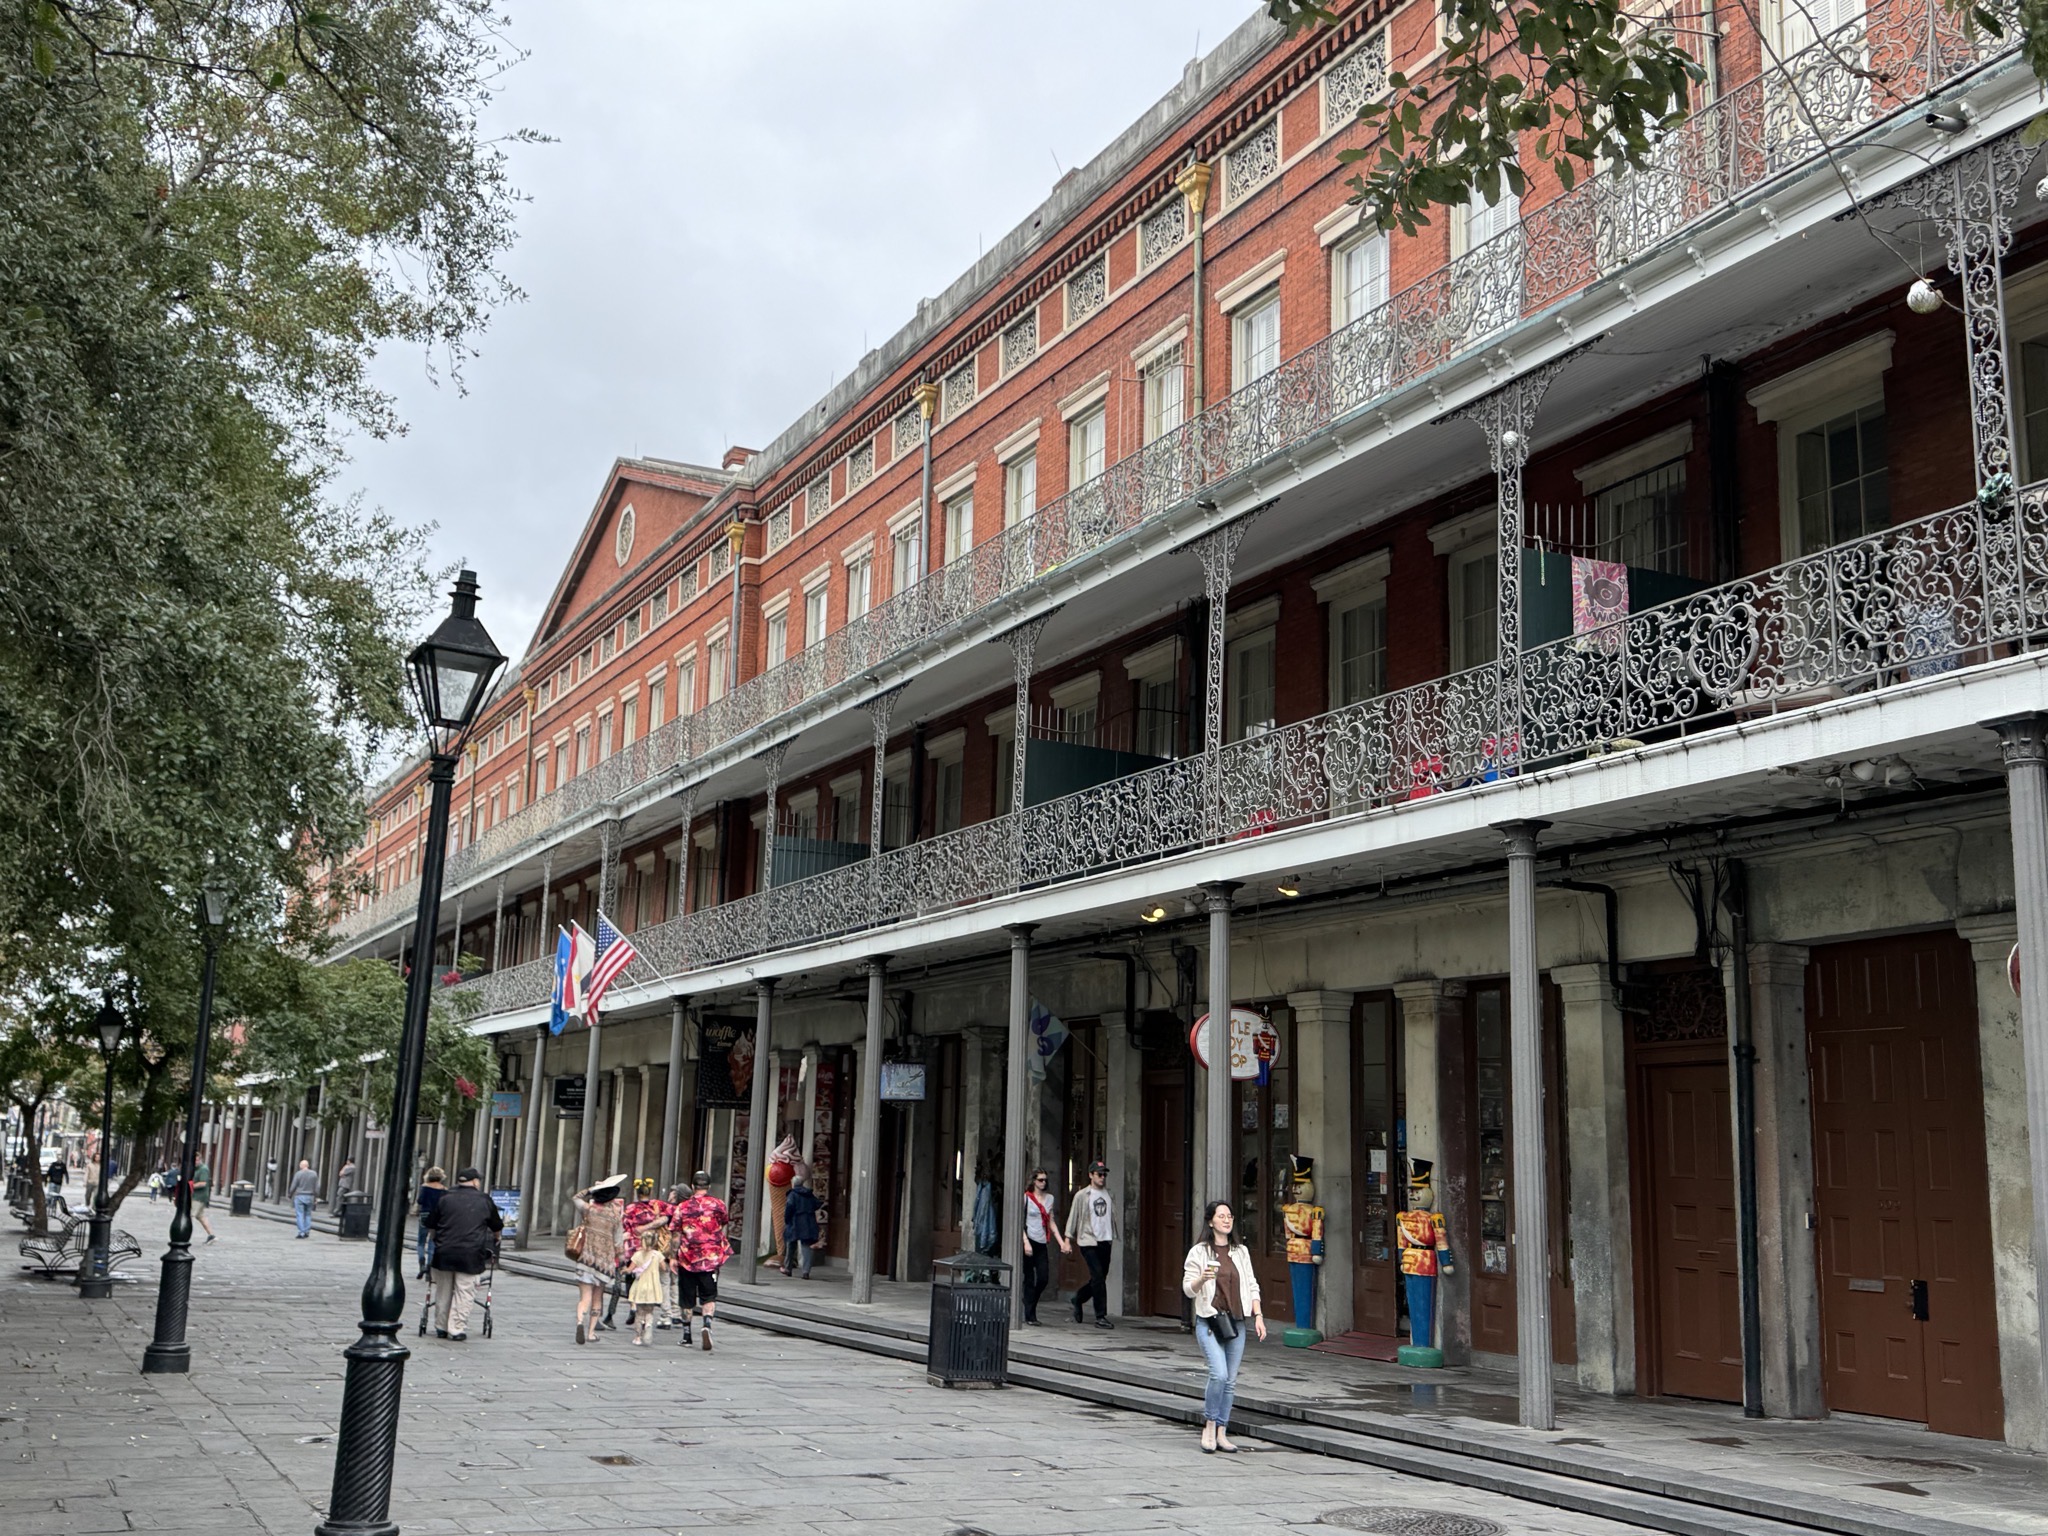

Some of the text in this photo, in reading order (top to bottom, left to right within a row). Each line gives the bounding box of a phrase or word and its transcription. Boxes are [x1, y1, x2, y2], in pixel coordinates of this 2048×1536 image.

[1230, 1019, 1251, 1035] TLE
[1230, 1037, 1243, 1051] OY
[1231, 1053, 1248, 1068] OP
